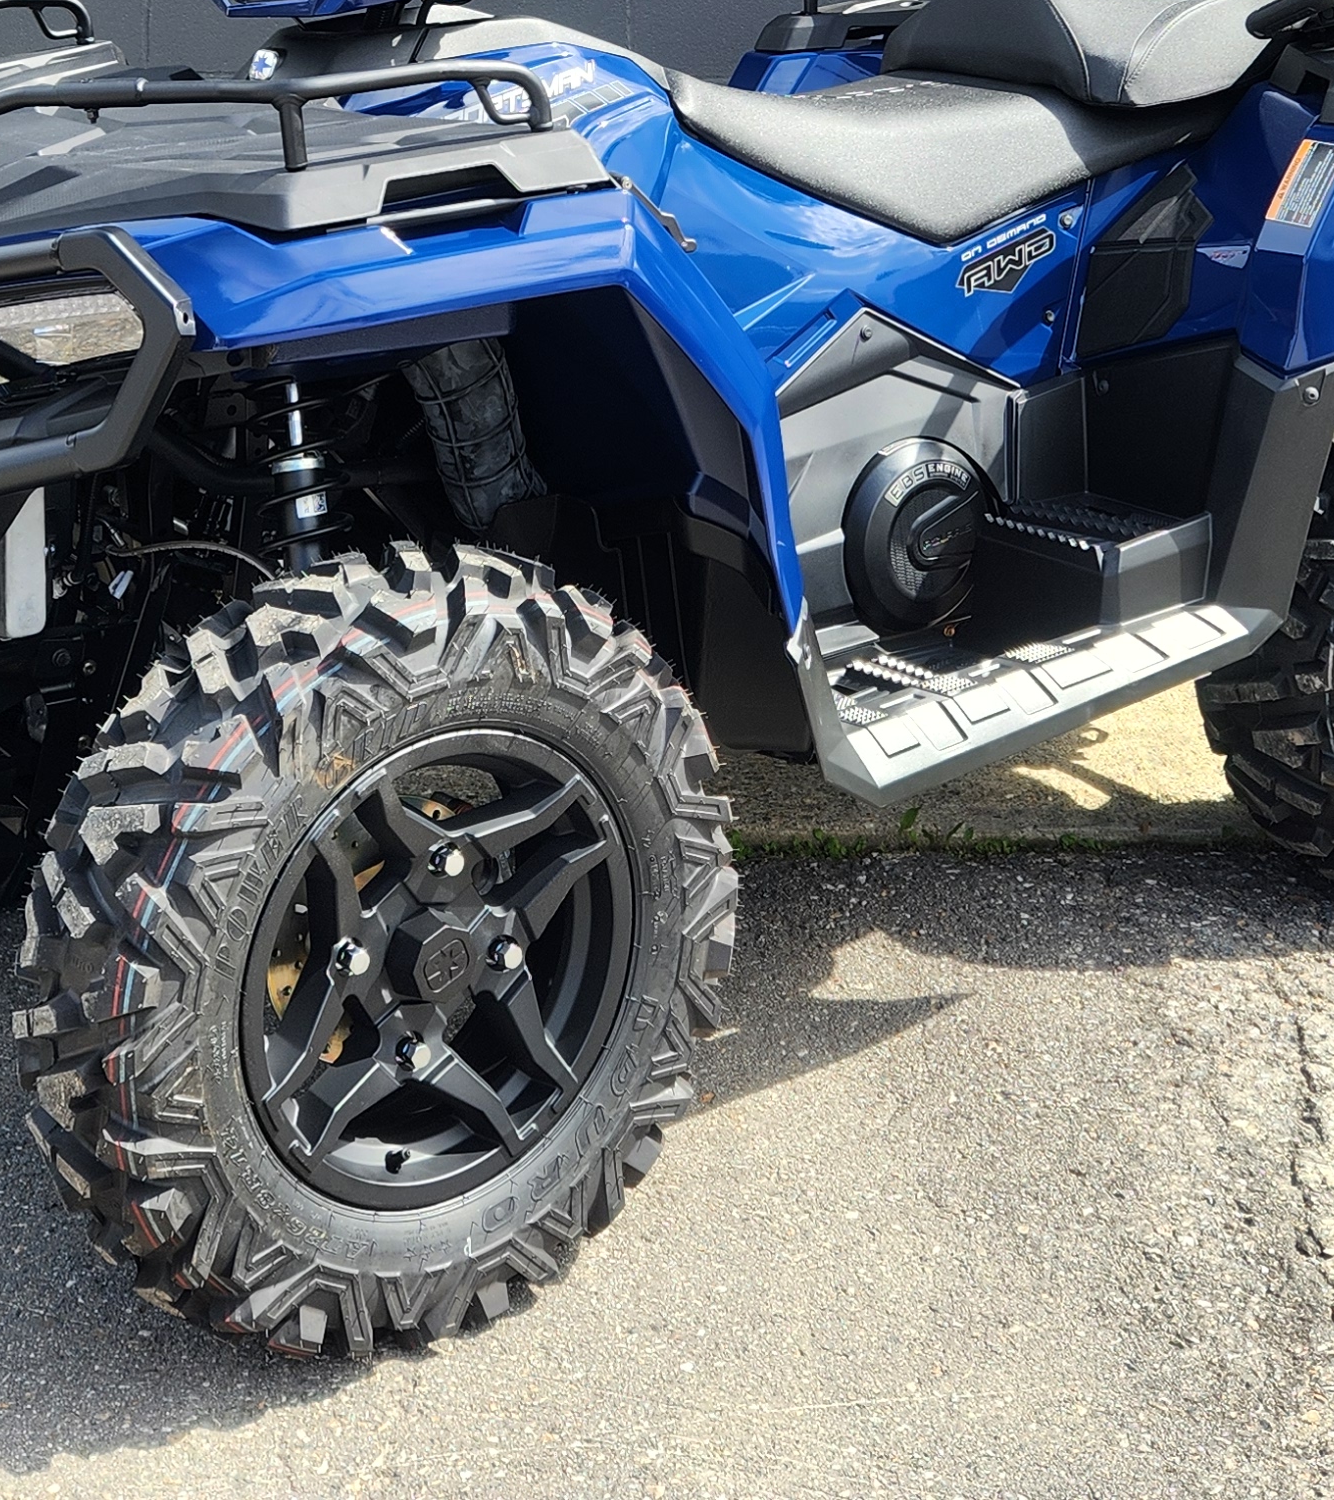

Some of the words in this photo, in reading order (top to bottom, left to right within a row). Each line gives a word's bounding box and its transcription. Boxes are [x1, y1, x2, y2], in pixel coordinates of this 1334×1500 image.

[964, 230, 1057, 298] AWD
[890, 466, 926, 501] EBS
[927, 462, 969, 484] ENGINE
[481, 1044, 639, 1234] DURO
